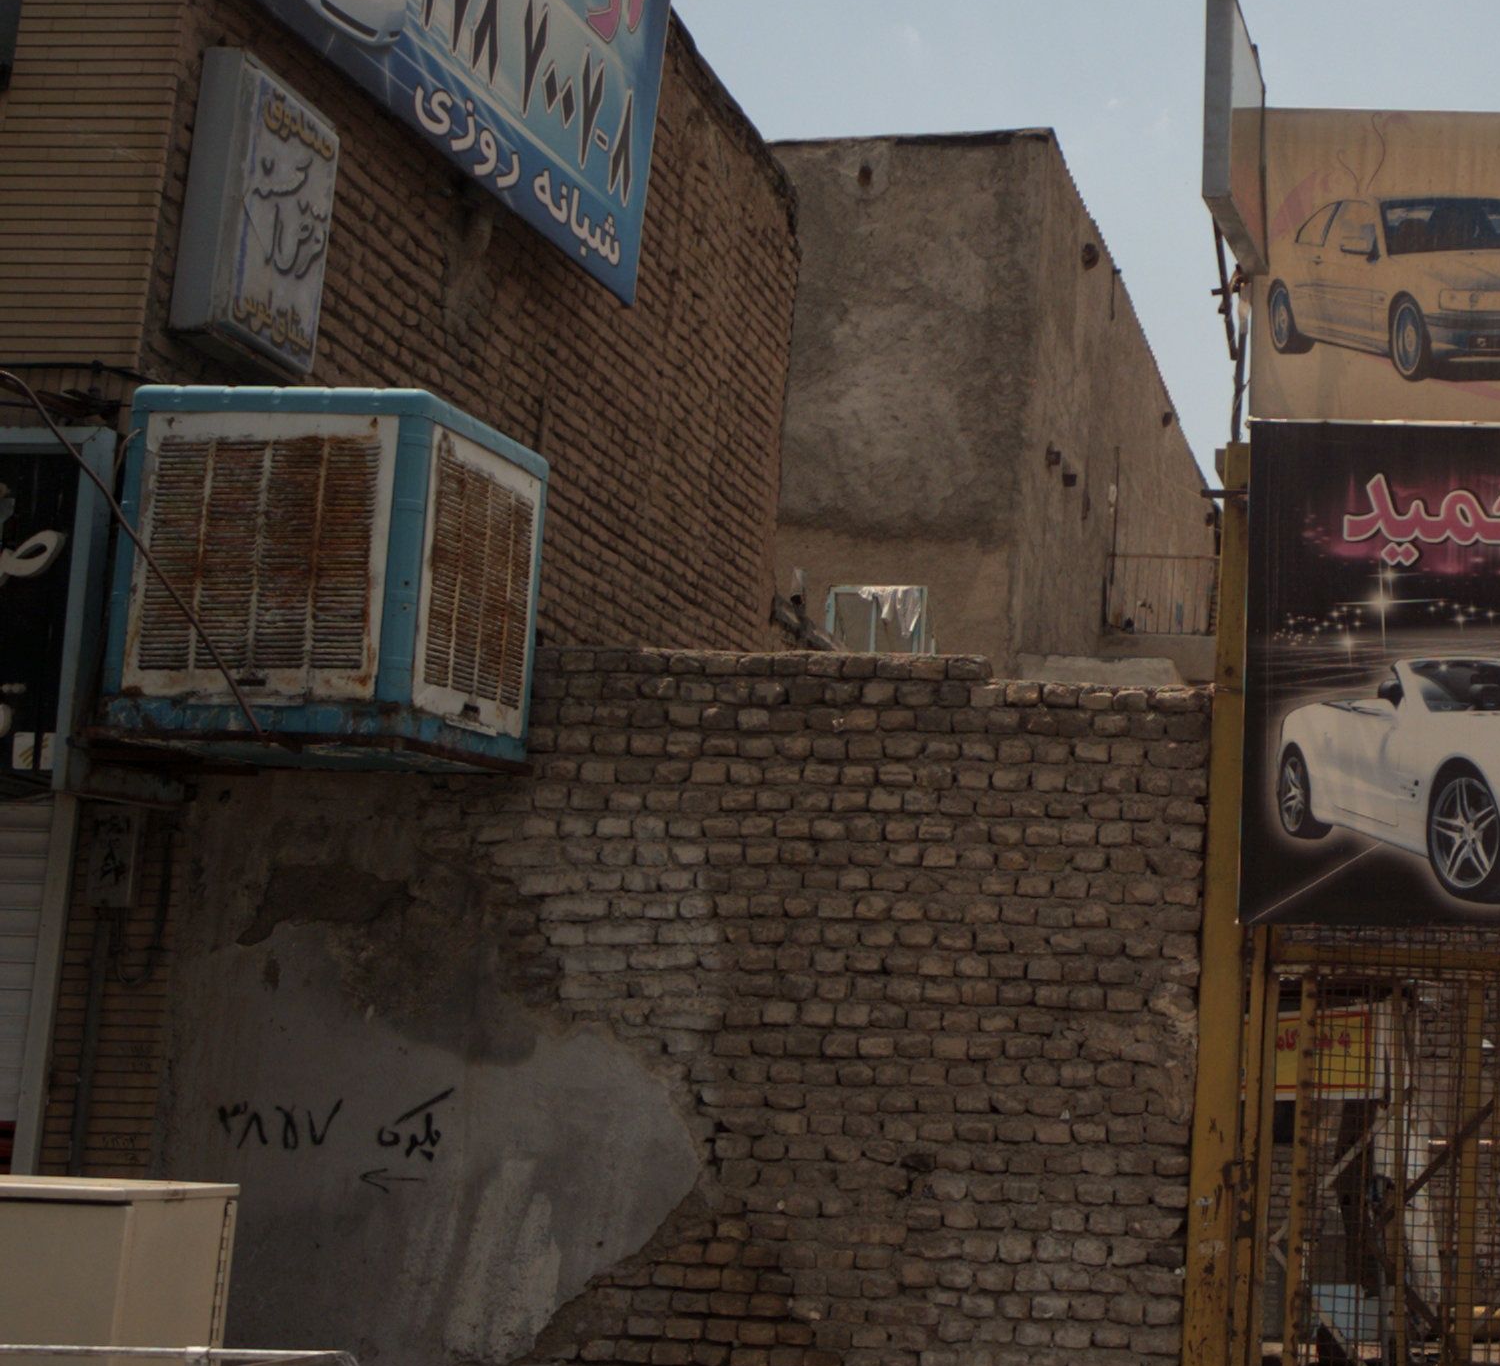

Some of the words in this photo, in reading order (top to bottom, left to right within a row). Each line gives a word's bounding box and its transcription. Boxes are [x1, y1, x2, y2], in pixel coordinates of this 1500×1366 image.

[264, 87, 335, 161] صندوق
[414, 85, 521, 190] روزی
[533, 168, 621, 266] شبانه
